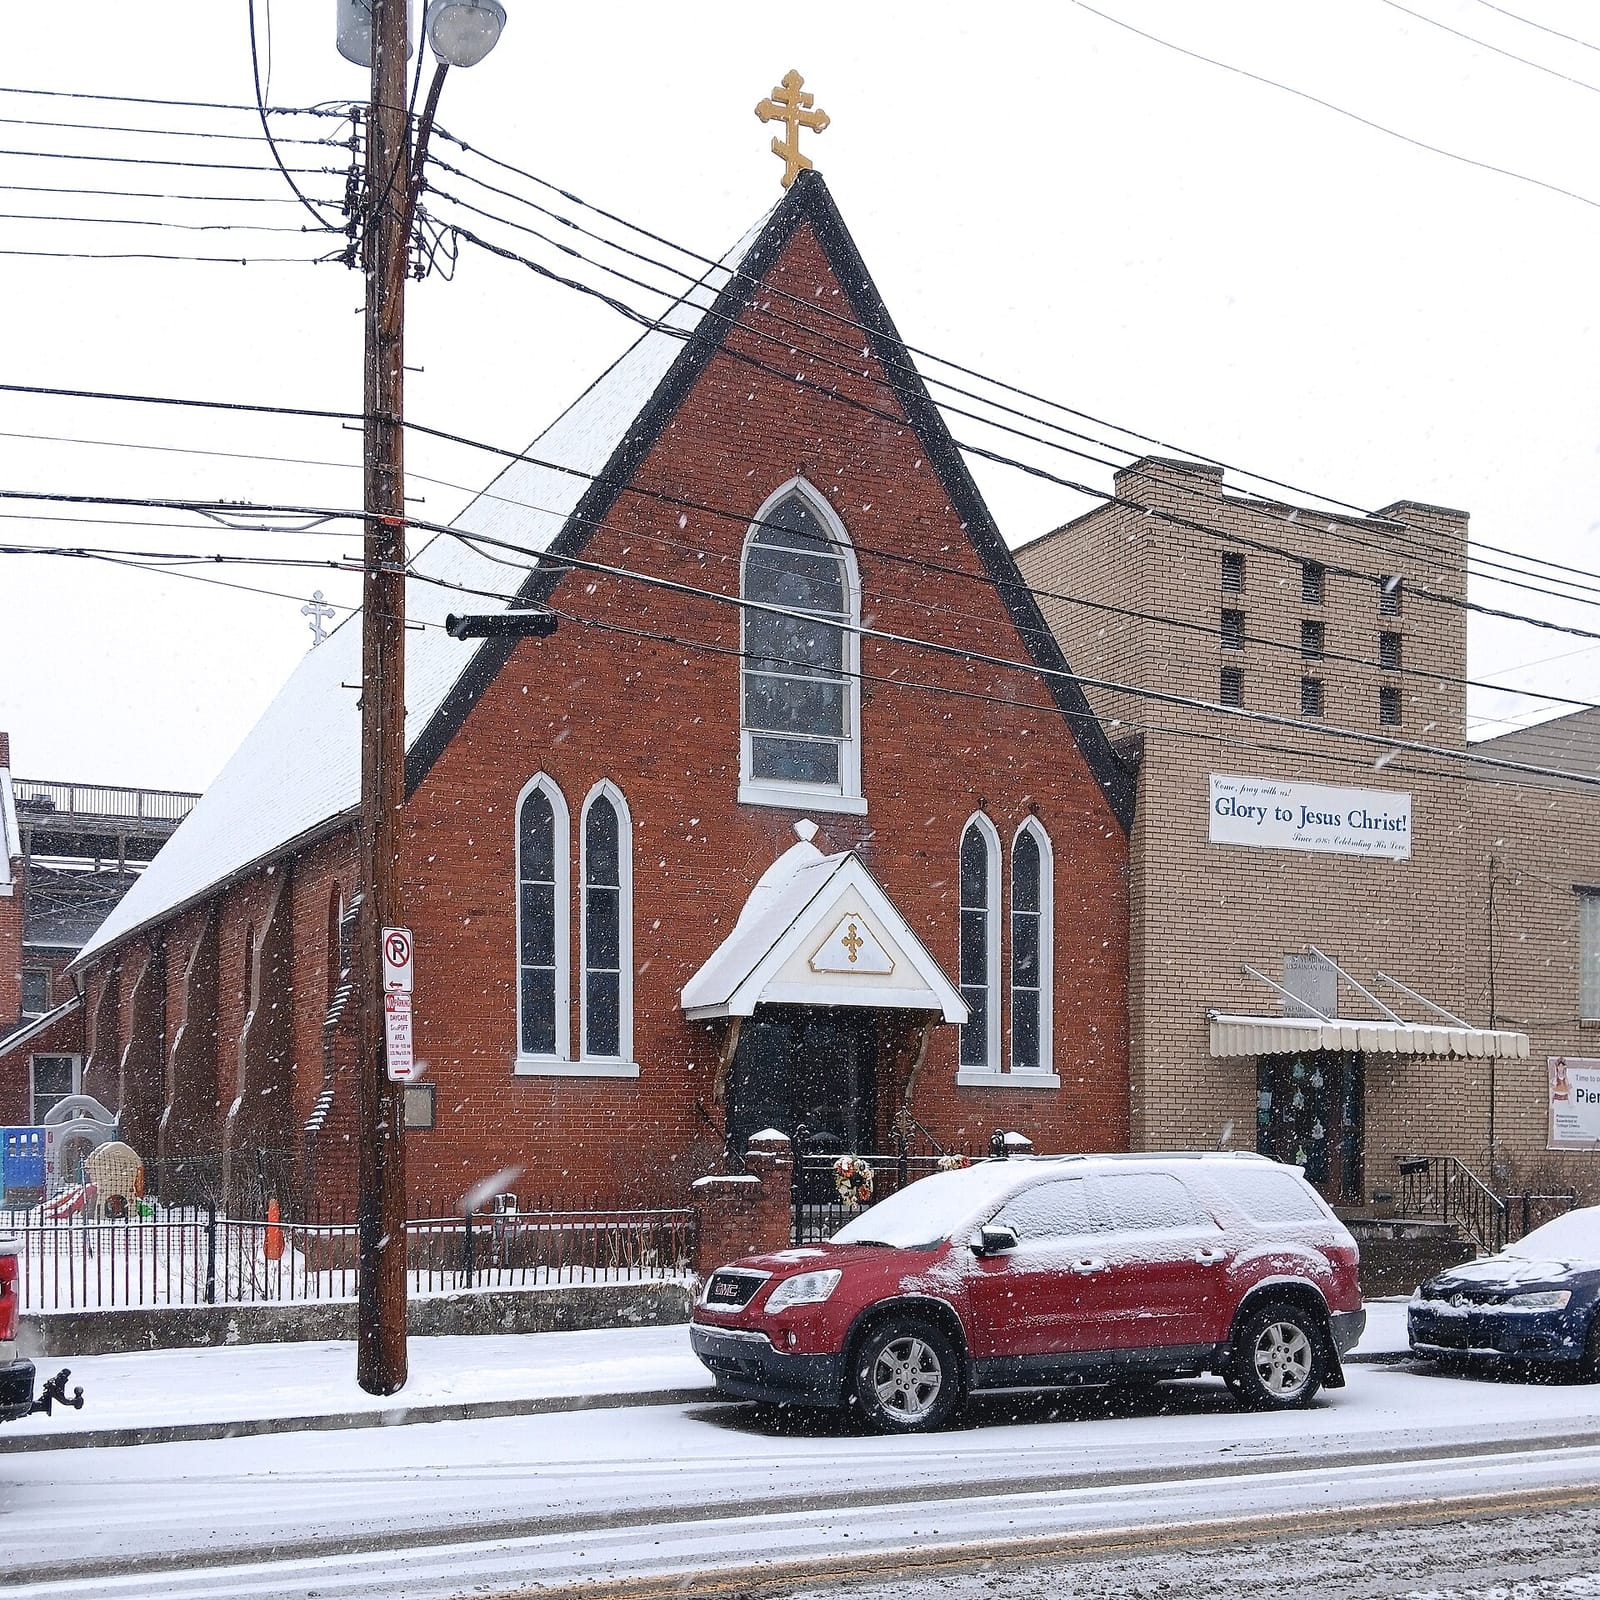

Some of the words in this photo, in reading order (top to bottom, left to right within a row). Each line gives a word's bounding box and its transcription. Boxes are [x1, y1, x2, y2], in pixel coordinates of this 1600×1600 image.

[1214, 779, 1238, 792] Come,
[1239, 784, 1259, 796] pray
[1261, 786, 1277, 795] with
[1280, 788, 1292, 797] us!
[1215, 796, 1268, 826] Glory
[1275, 806, 1293, 822] to
[1297, 805, 1341, 829] Jesus
[1347, 809, 1407, 832] Christ!
[1292, 832, 1313, 843] Since
[1334, 836, 1372, 851] Celebrating
[715, 1283, 738, 1297] GMC
